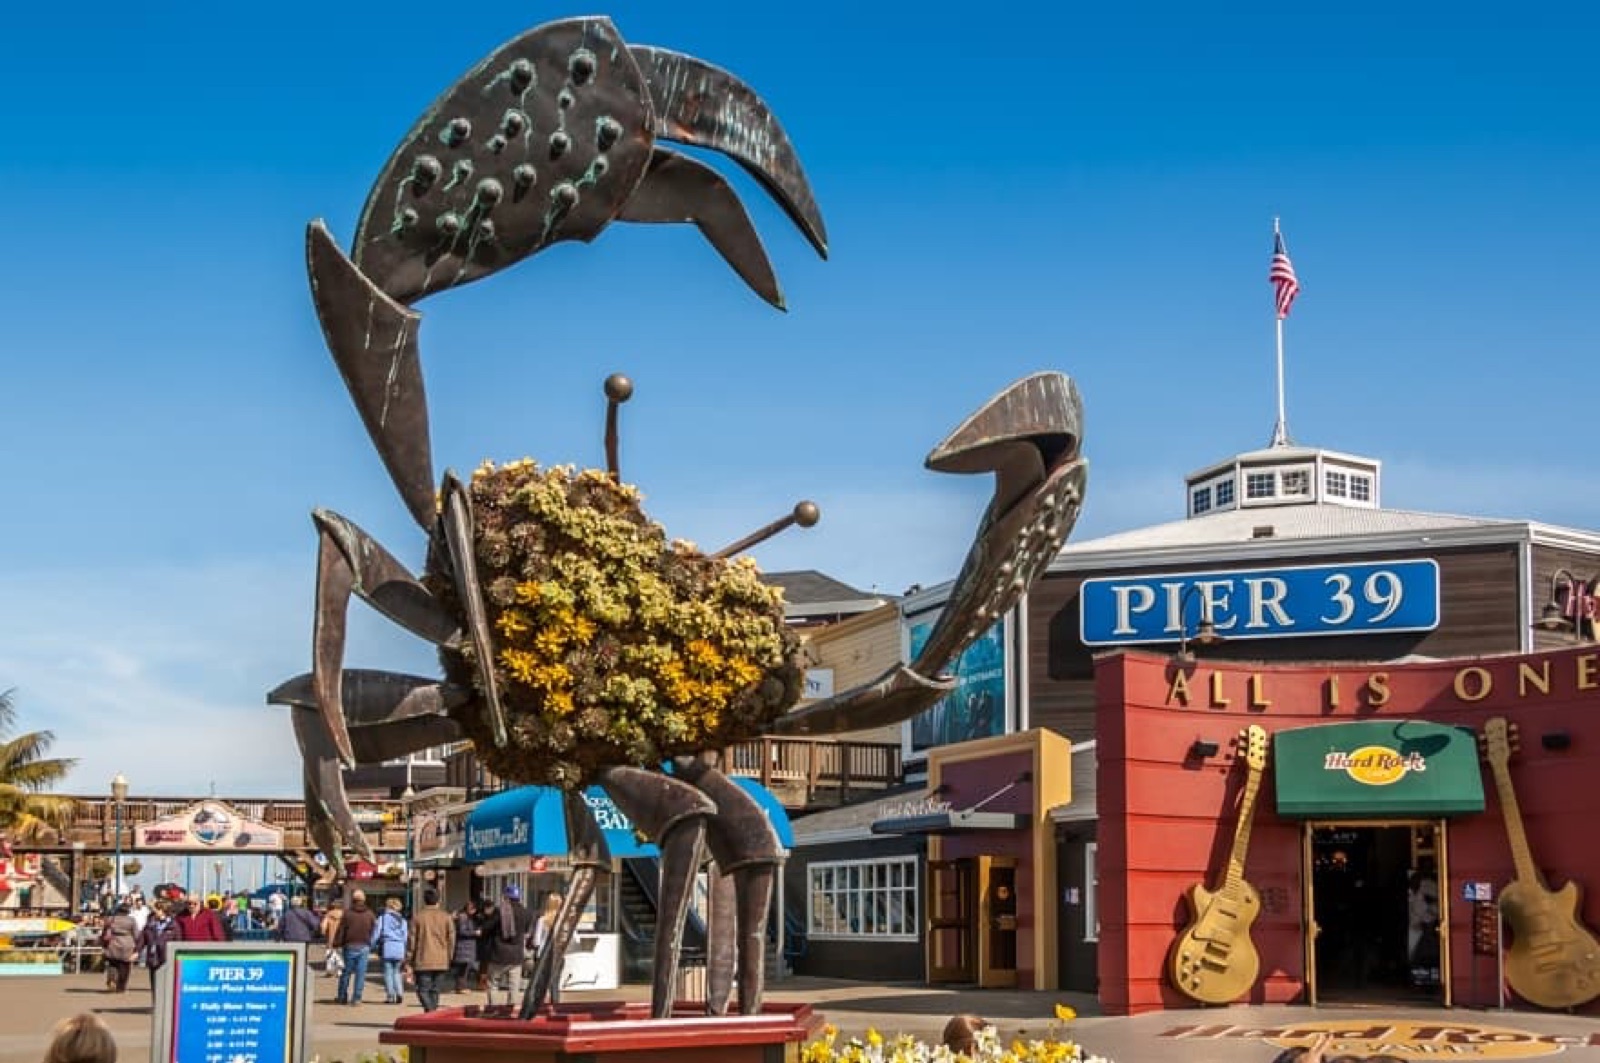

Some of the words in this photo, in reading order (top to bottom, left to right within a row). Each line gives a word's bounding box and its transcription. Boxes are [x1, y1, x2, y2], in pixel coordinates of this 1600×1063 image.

[1111, 577, 1295, 634] PIER
[1320, 571, 1403, 624] 39
[1169, 668, 1272, 706] ALL
[1329, 672, 1390, 706] IS
[1453, 655, 1600, 701] ONE
[1324, 752, 1374, 769] Hard
[1377, 752, 1426, 771] Rock
[209, 967, 245, 980] PIER
[246, 967, 263, 980] 39
